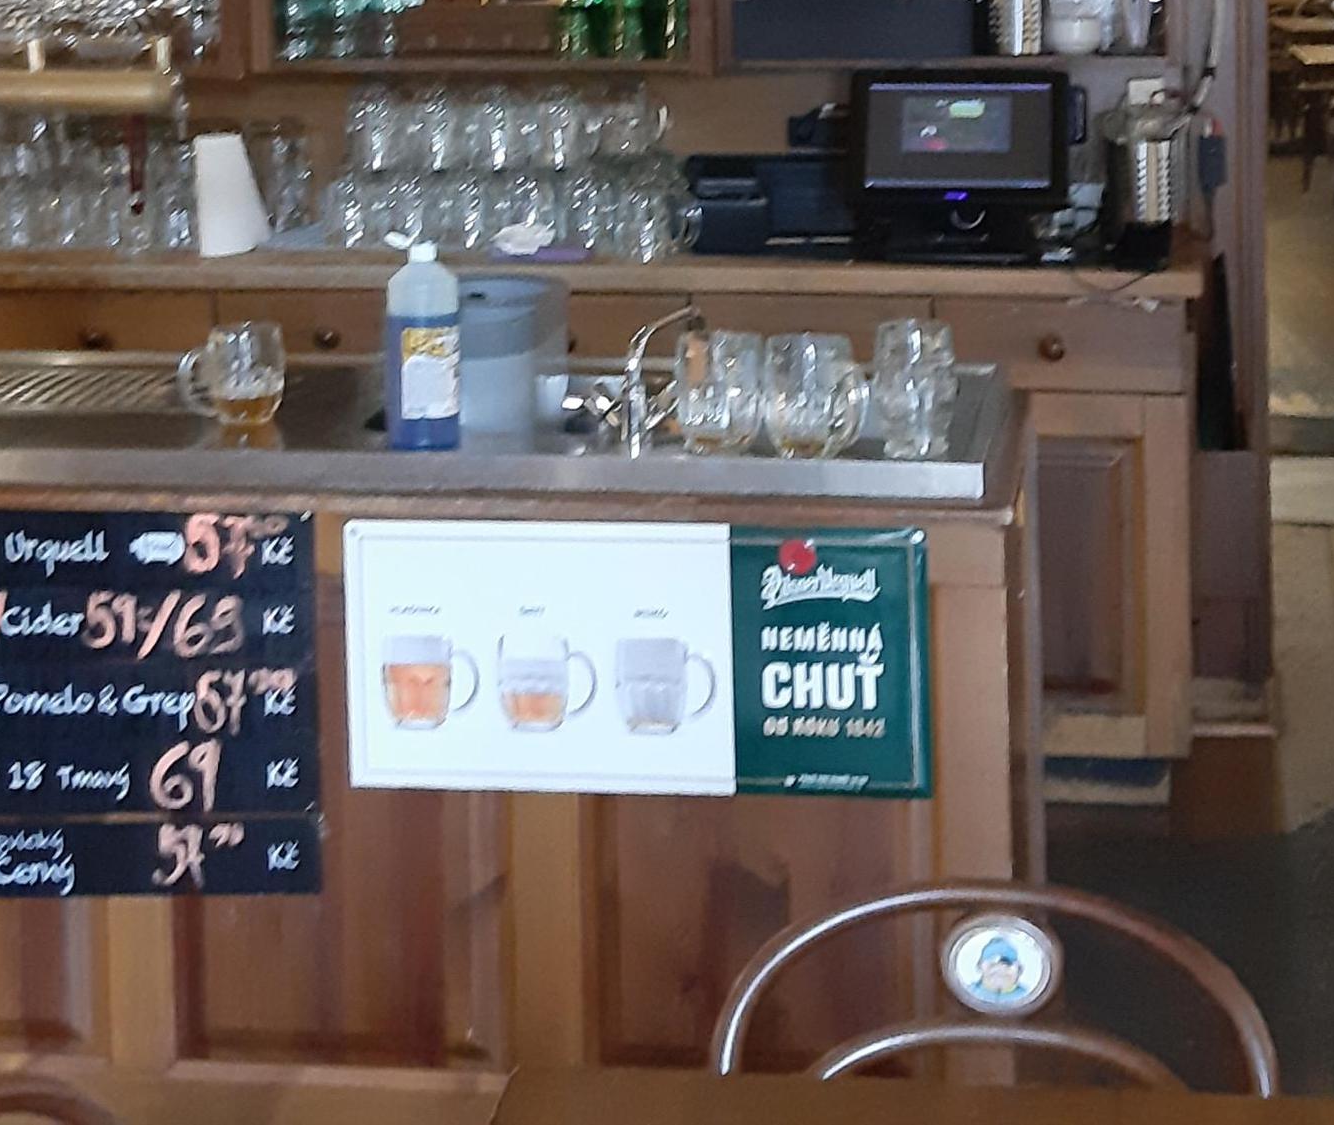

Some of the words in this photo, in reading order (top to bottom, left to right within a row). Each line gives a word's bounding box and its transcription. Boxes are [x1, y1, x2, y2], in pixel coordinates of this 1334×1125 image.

[4, 529, 110, 577] Urquell
[761, 621, 883, 652] NEMĚNNÁ
[761, 650, 885, 710] CHUŤ
[7, 760, 47, 791] 18
[149, 738, 221, 812] 69
